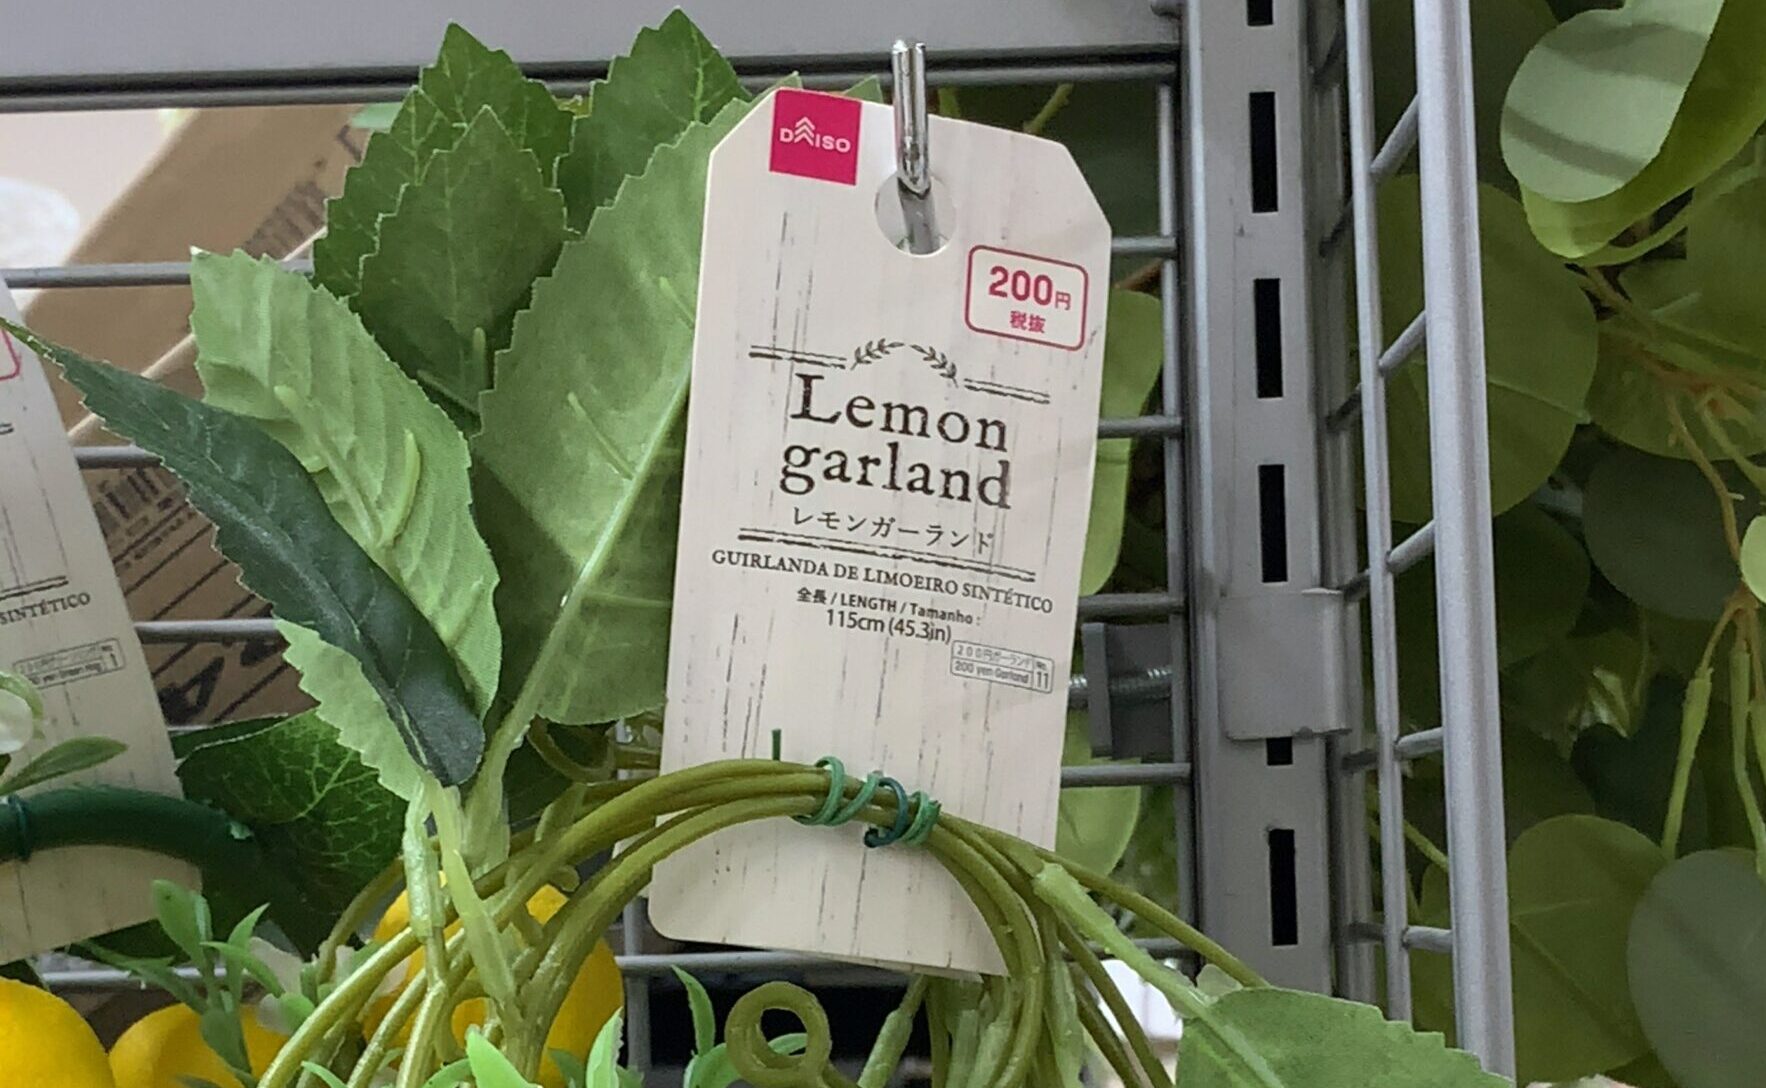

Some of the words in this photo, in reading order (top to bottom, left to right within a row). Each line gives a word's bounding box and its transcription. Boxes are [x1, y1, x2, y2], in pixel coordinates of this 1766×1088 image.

[779, 116, 851, 154] DAISO
[988, 265, 1071, 311] 200円
[1009, 310, 1046, 334] 税抜
[790, 372, 1008, 452] Lemon
[778, 441, 1011, 510] garland
[792, 507, 995, 555] レモンガーランド
[712, 550, 829, 577] GUIRLANDA
[832, 560, 859, 581] DE
[862, 567, 959, 596] LIMOEIRO
[961, 582, 1054, 614] SINTÉTICO
[796, 586, 828, 605] 全長
[840, 592, 897, 613] LENGTH
[826, 608, 886, 633] 115cm
[1035, 671, 1050, 690] 11
